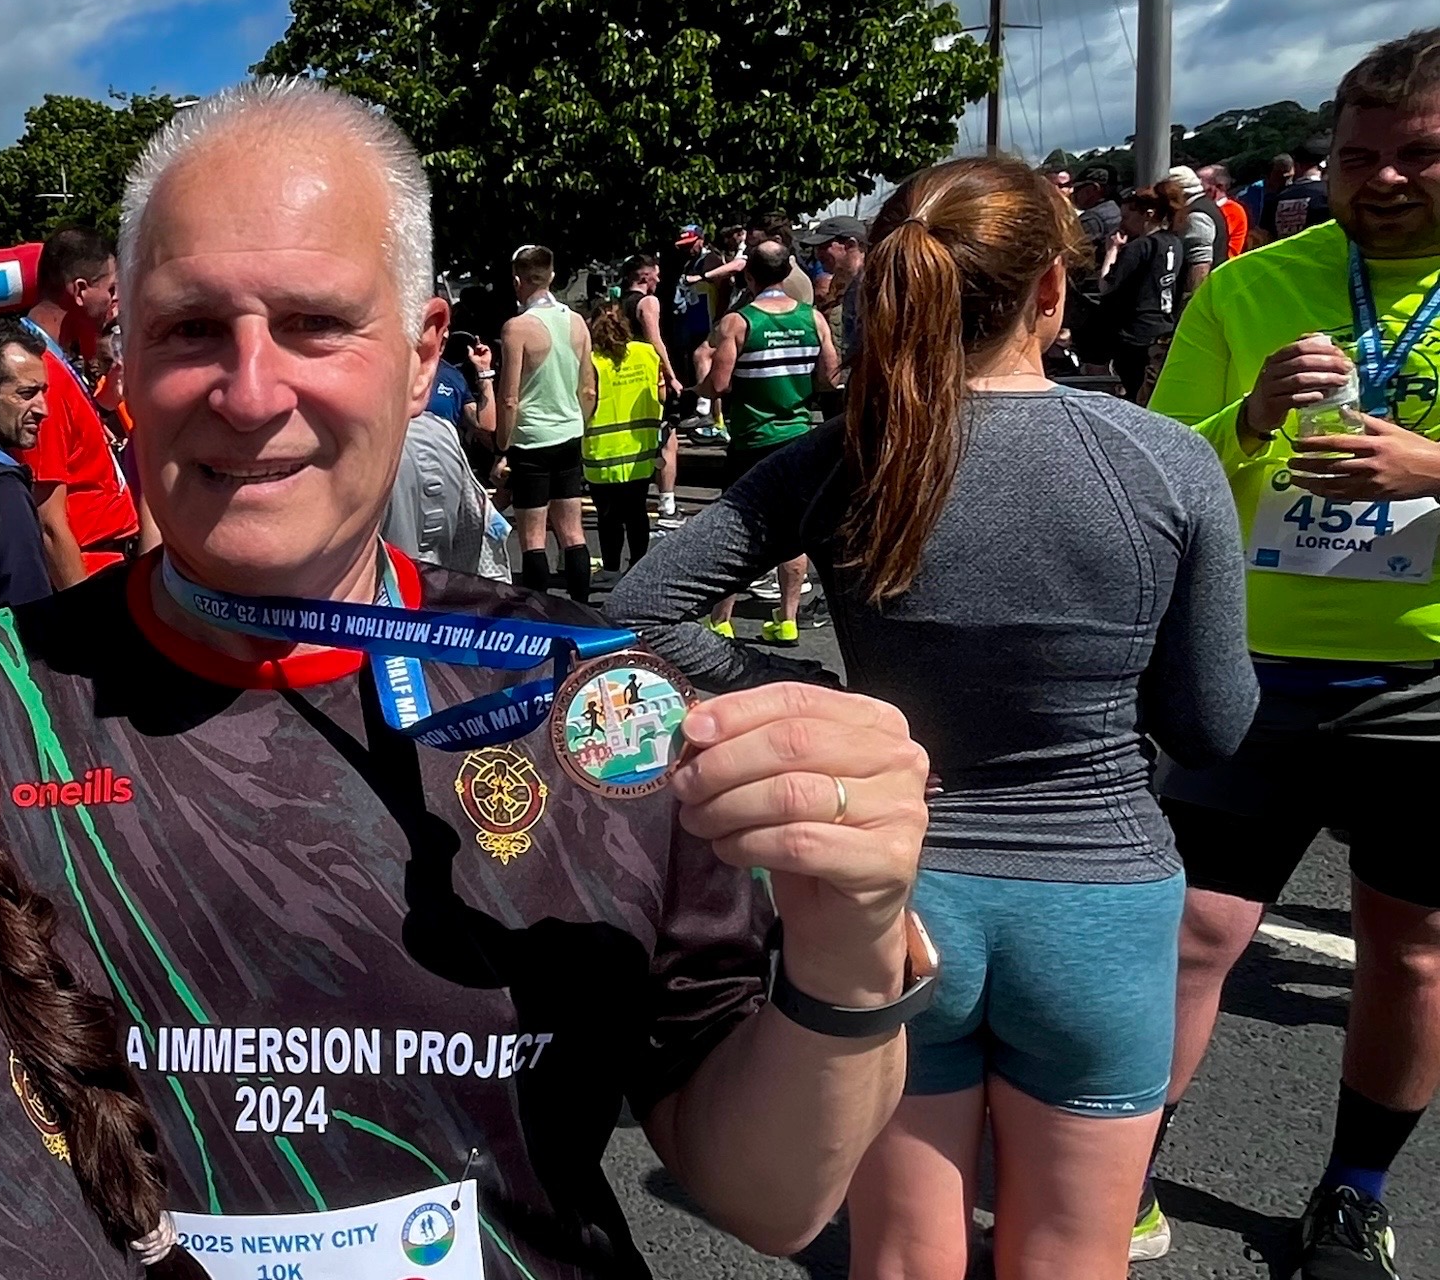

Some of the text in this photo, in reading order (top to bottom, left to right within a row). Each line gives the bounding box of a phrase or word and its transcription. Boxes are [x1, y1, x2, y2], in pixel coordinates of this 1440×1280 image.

[1283, 494, 1395, 537] 454
[1295, 534, 1374, 553] LORCAN
[194, 594, 230, 620] 2025
[261, 607, 295, 628] MAY
[299, 609, 326, 632] 10K
[345, 614, 432, 644] MARATHON
[431, 624, 474, 650] HALF
[474, 629, 515, 653] CITY
[384, 655, 413, 695] HALF
[459, 714, 491, 739] 10K
[488, 700, 529, 732] MAY
[11, 767, 134, 808] oneills
[157, 1026, 381, 1076] IMMERSION
[395, 1028, 554, 1079] PROJECT
[234, 1085, 329, 1134] 2024
[177, 1222, 379, 1255] 2025 NEWRY CITY
